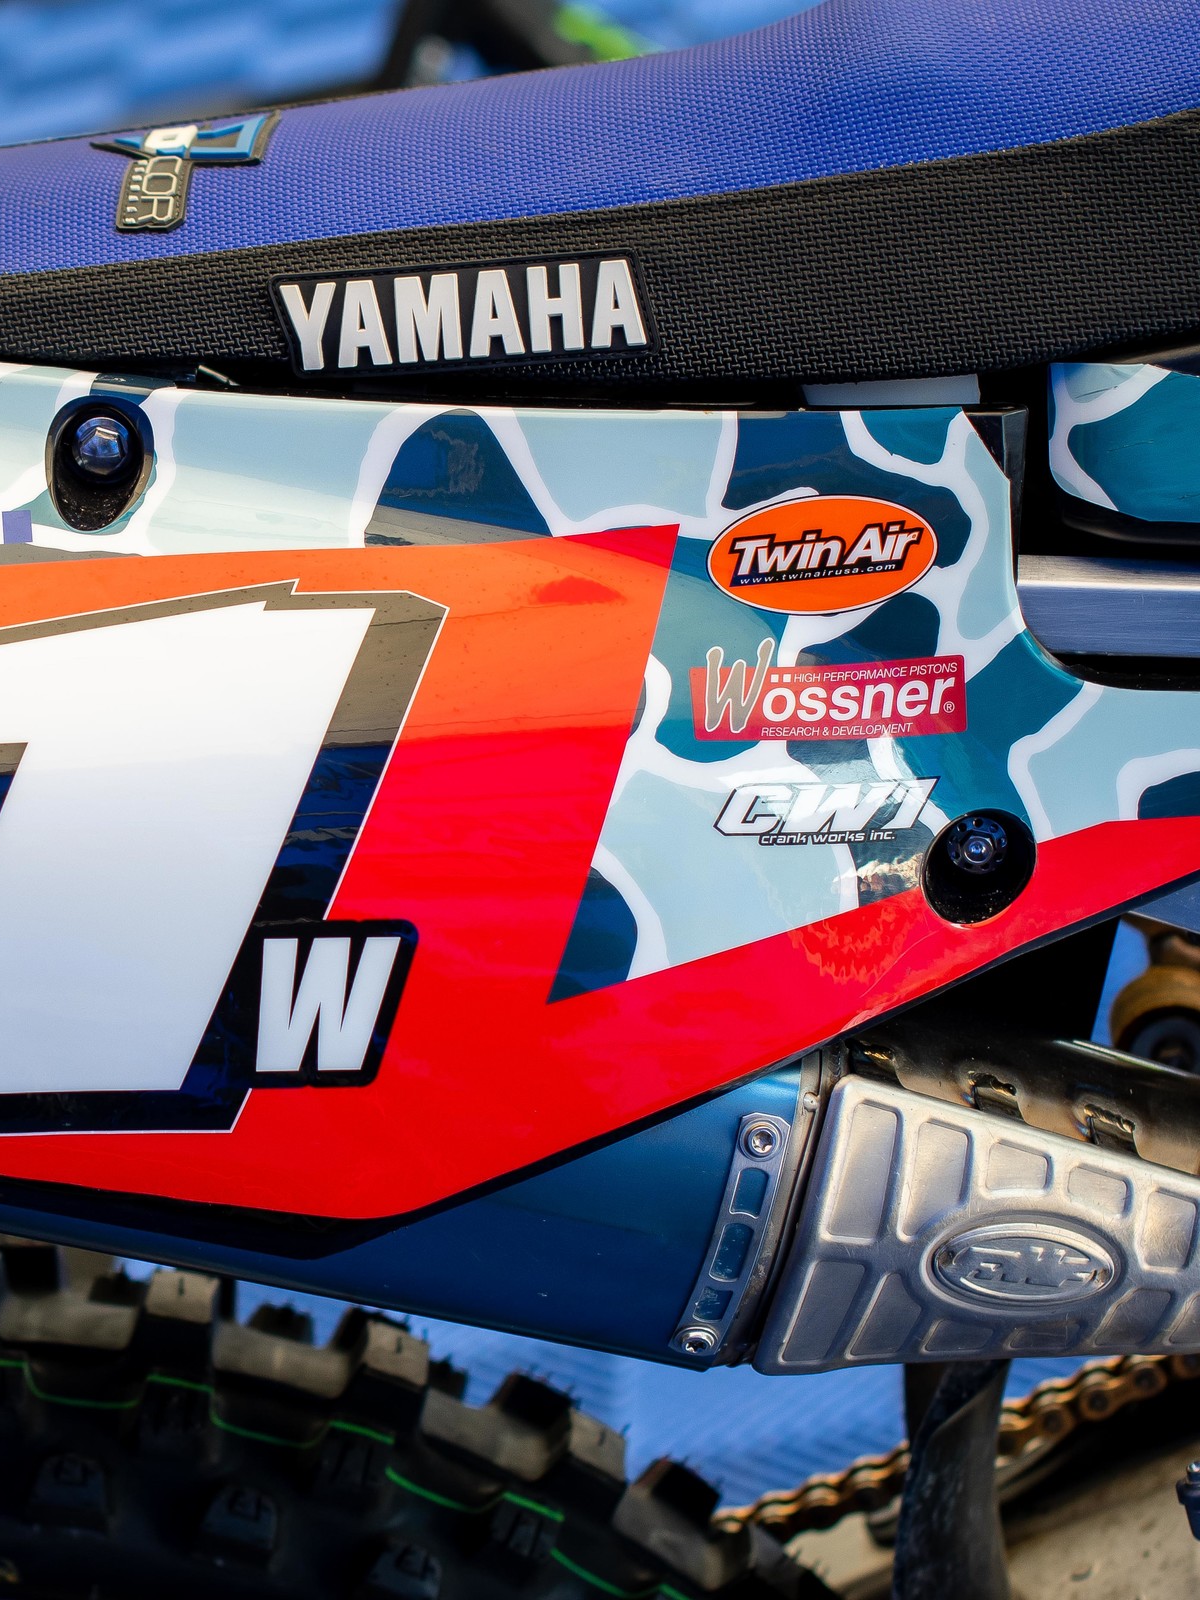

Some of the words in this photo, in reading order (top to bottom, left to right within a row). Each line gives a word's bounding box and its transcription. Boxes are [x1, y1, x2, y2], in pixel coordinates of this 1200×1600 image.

[279, 260, 648, 371] YAMAHA
[733, 533, 842, 576] Twin
[844, 524, 921, 565] Air
[739, 562, 897, 586] www.twinairusa.com
[793, 672, 821, 683] HIGH
[823, 666, 907, 682] PERFORMANCE
[909, 662, 958, 675] PISTONS
[761, 725, 820, 737] RESEARCH
[822, 727, 829, 736] &
[831, 722, 914, 737] DEVELOPMENT
[760, 833, 807, 845] crank
[812, 831, 865, 843] works
[869, 830, 896, 841] inc.
[256, 936, 401, 1072] W
